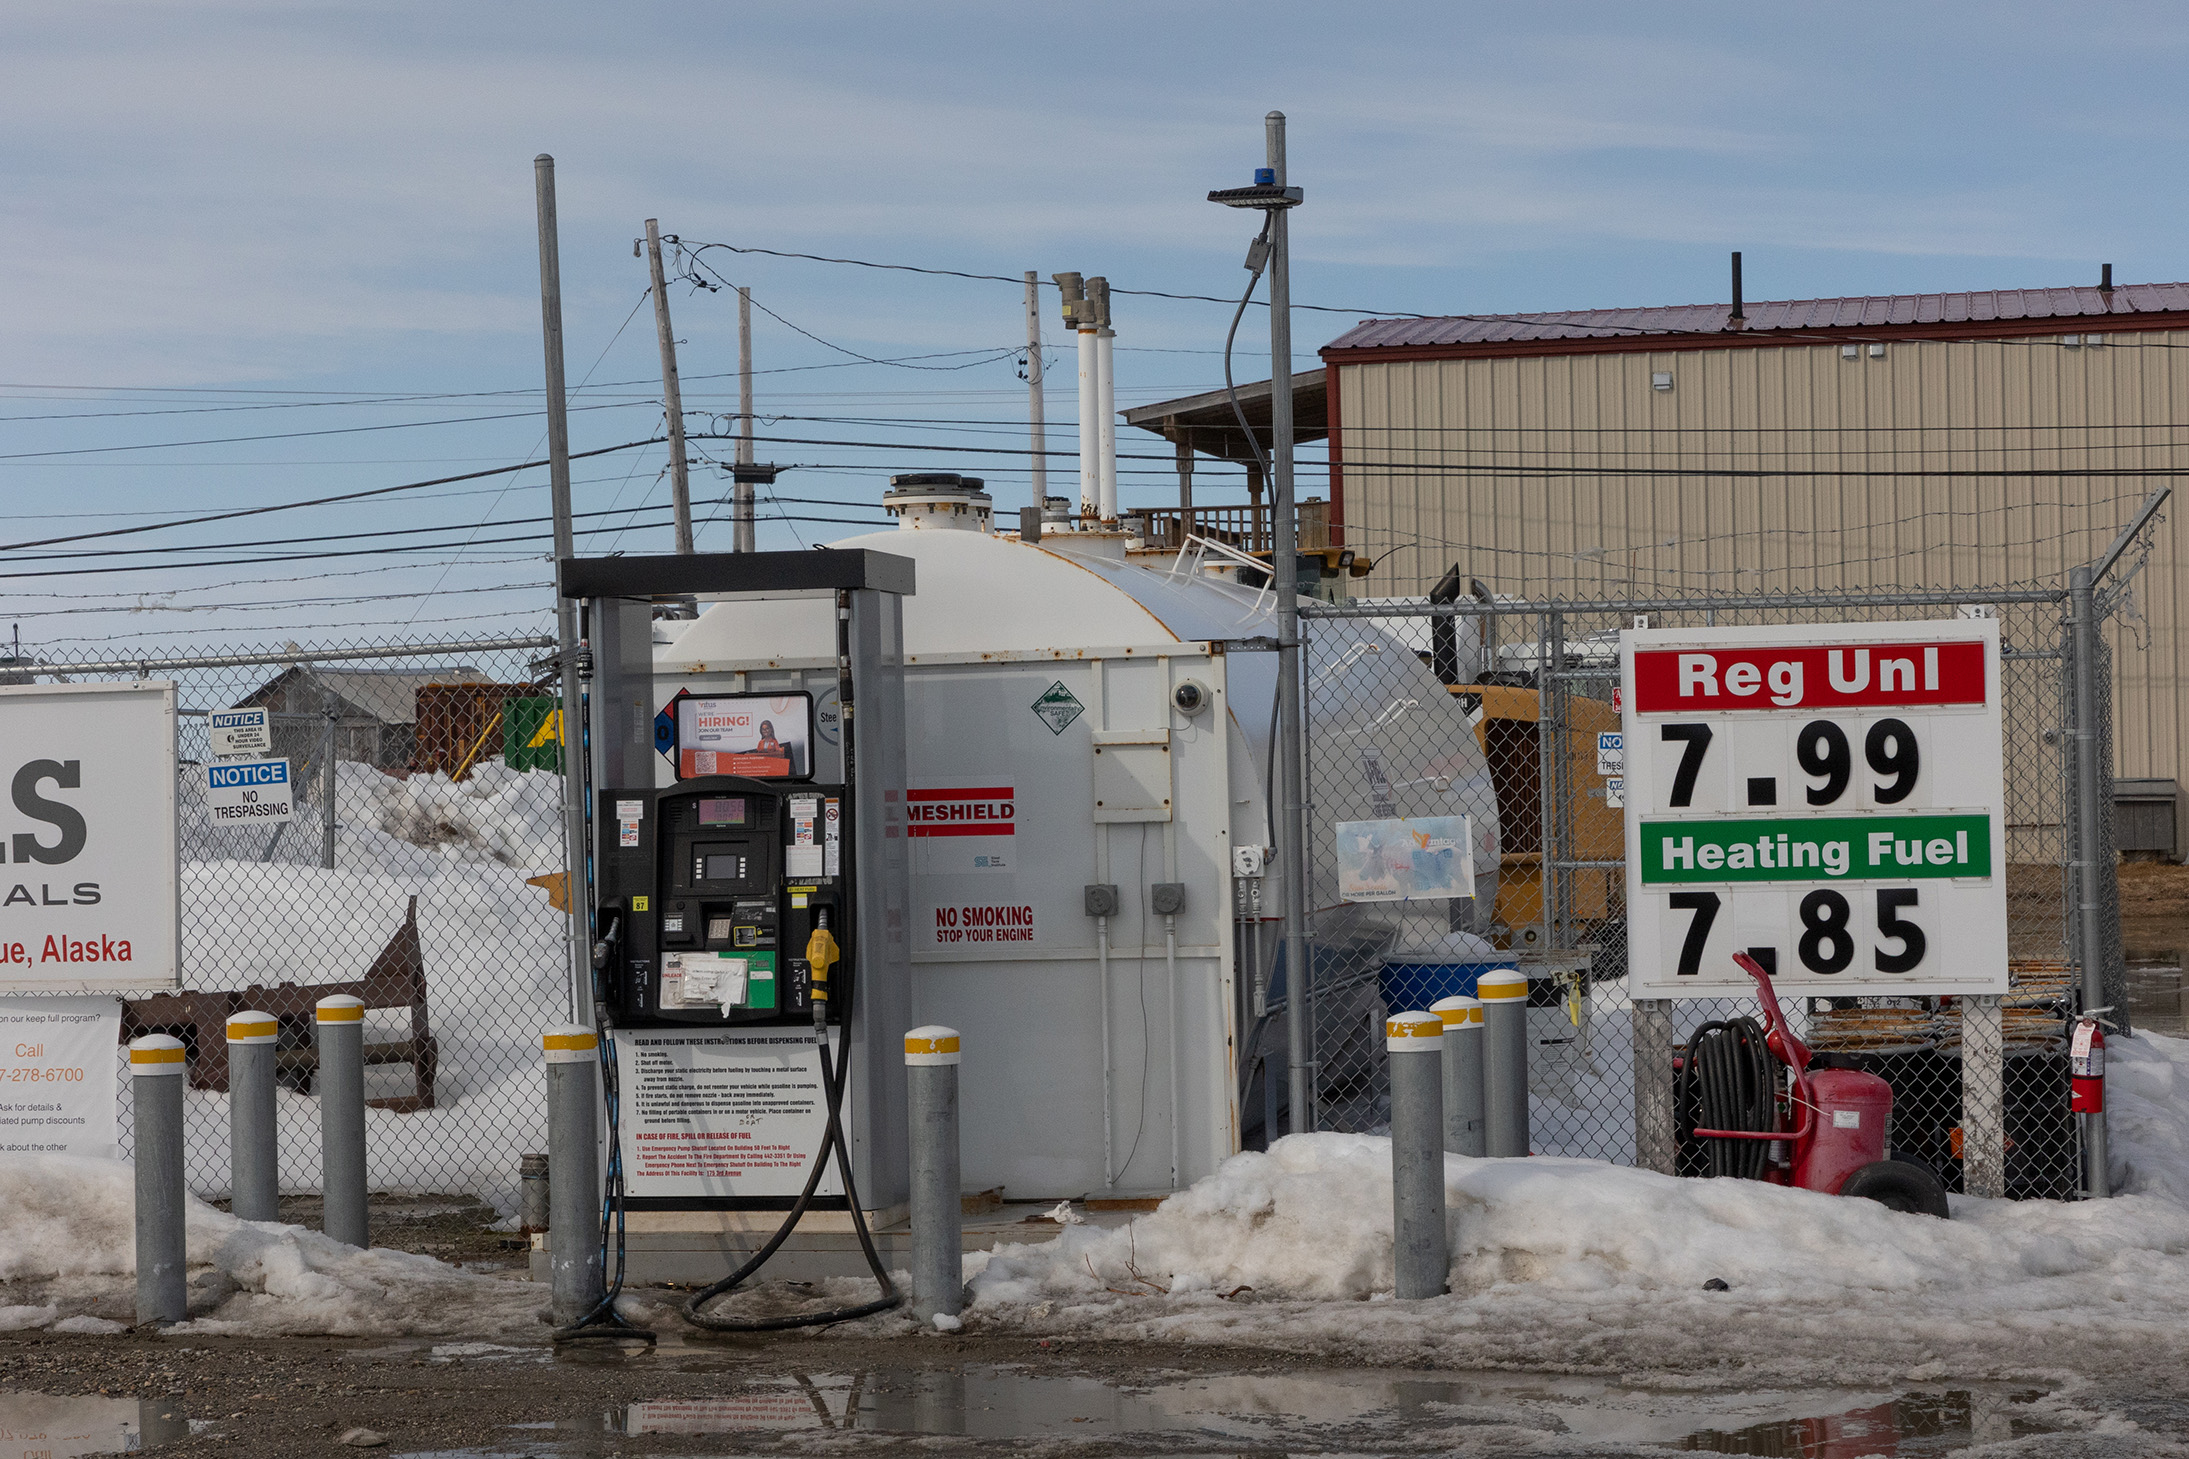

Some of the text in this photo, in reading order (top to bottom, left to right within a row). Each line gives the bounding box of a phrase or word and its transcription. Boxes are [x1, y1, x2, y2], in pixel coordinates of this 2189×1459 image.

[1677, 653, 1805, 708] Reg
[214, 713, 262, 727] NOTICE
[699, 716, 749, 727] HIRING!
[1658, 717, 1922, 808] 7.99
[213, 765, 283, 786] NOTICE
[242, 790, 258, 803] NO
[0, 758, 88, 866] S
[214, 802, 288, 819] TRESPASSING
[1661, 830, 1970, 878] Heating Fuel
[936, 905, 1033, 927] NO SMOKING
[937, 928, 1033, 942] STOP YOUR ENGINE
[1667, 887, 1928, 976] 7.85
[40, 933, 132, 963] Alaska
[26, 1014, 45, 1024] keep
[61, 1014, 100, 1025] program?
[15, 1043, 44, 1058] Call
[28, 1103, 54, 1111] details
[56, 1103, 62, 1111] &
[21, 1118, 44, 1126] pump
[46, 1116, 85, 1124] discounts
